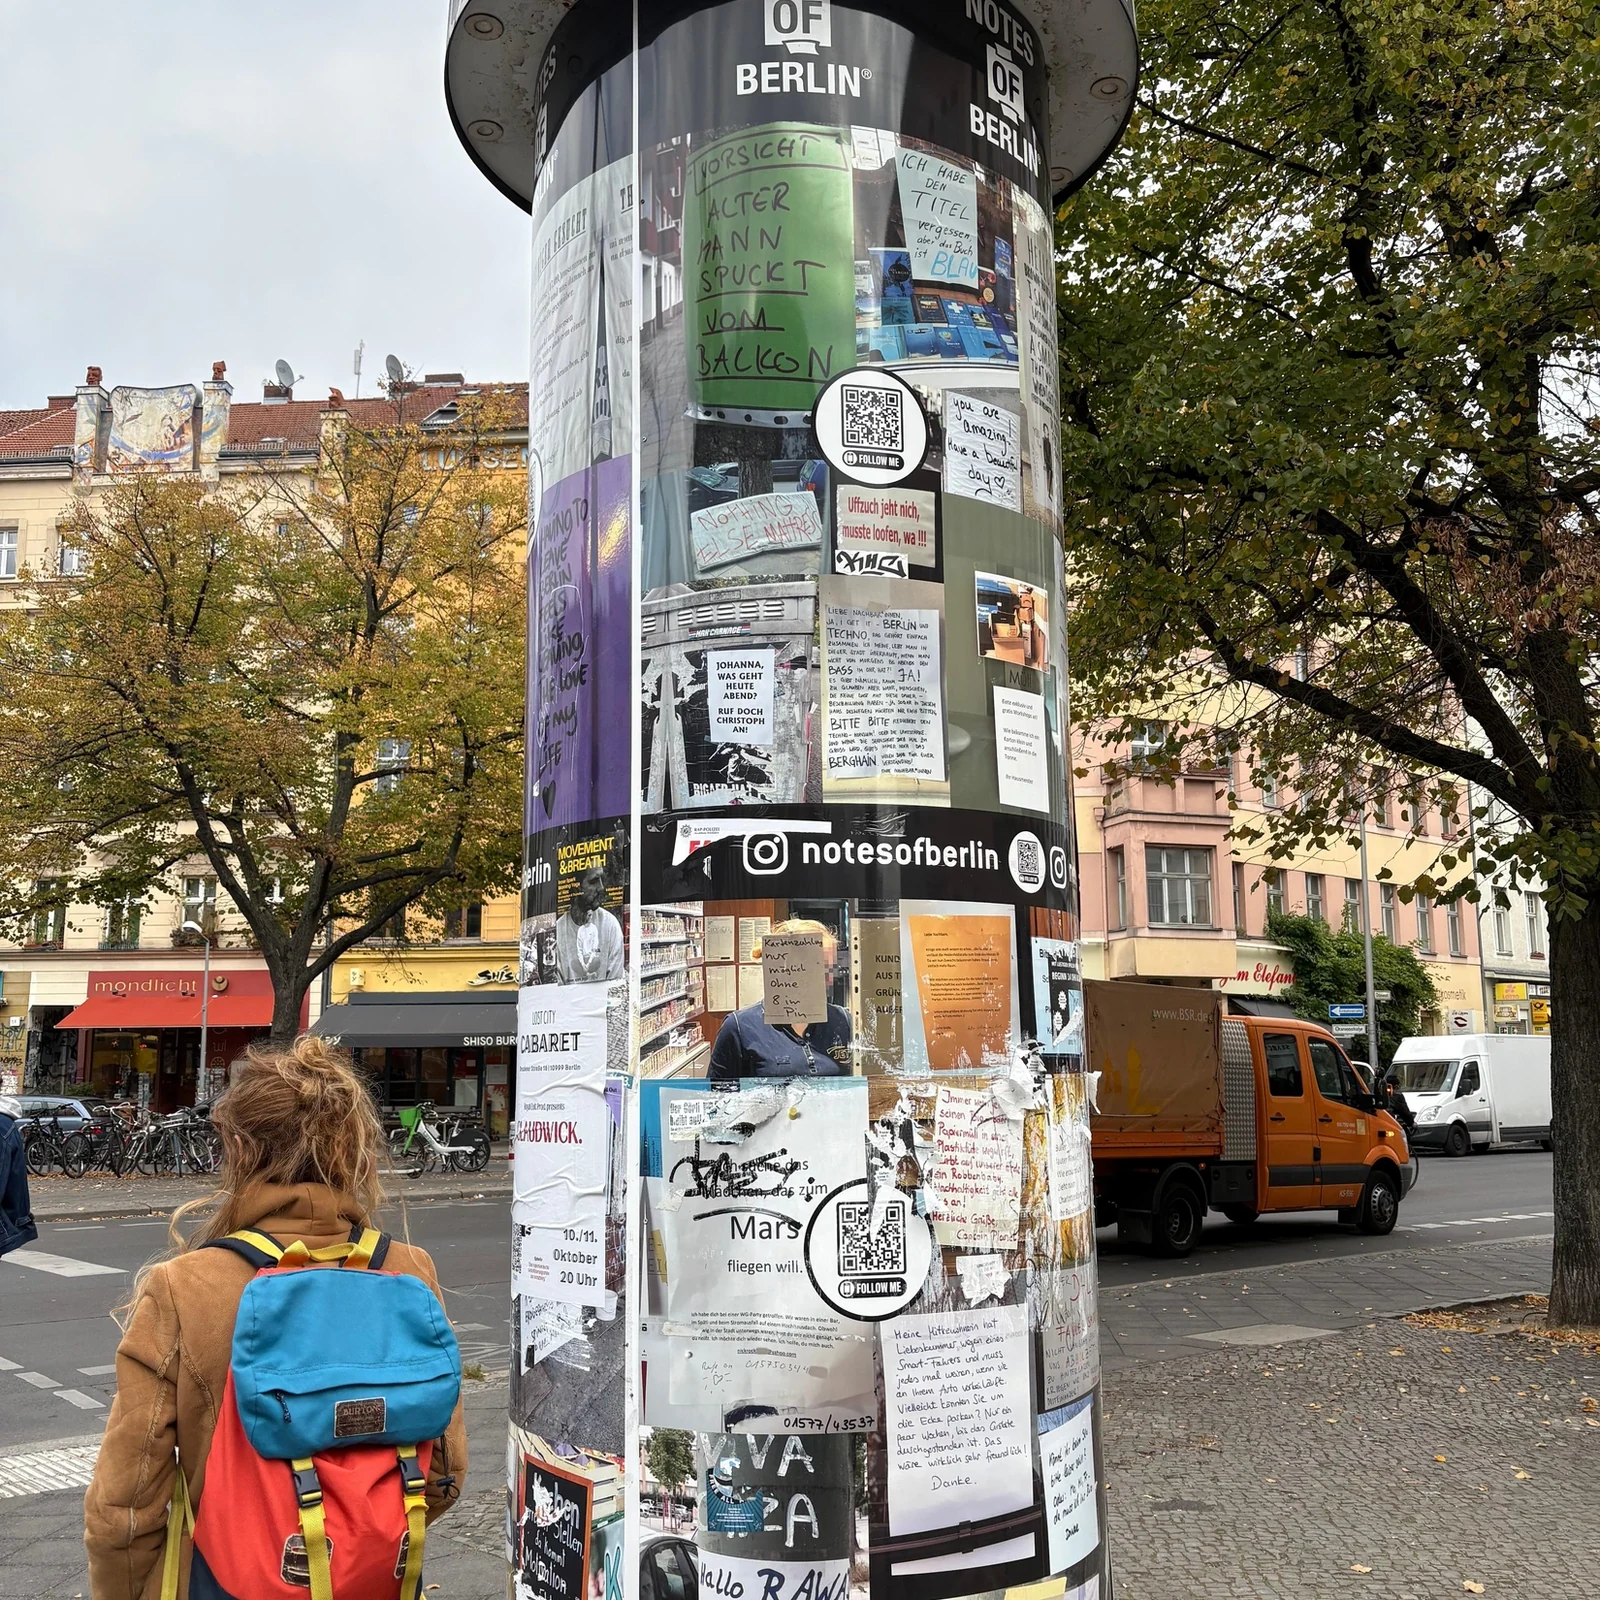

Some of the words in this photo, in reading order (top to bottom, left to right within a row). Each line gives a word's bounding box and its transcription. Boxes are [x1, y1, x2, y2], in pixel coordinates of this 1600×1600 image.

[773, 0, 822, 34] OF
[965, 0, 1034, 66] NOTES
[992, 61, 1020, 103] OF
[701, 135, 820, 178] VORSICHT
[901, 153, 928, 172] ICH
[937, 165, 968, 185] HABE
[925, 178, 947, 191] DEN
[911, 190, 970, 221] TITEL
[697, 225, 783, 265] MANN
[917, 235, 935, 245] aber
[953, 240, 973, 257] Buch
[914, 248, 929, 258] ist
[930, 250, 978, 279] BLAU
[701, 260, 826, 292] SPUCKT
[706, 307, 767, 333] VOM
[952, 397, 974, 420] you
[983, 405, 1000, 420] are
[948, 437, 967, 456] Have
[972, 451, 979, 459] a
[859, 454, 887, 466] FOLLOW
[889, 456, 900, 467] ME
[968, 465, 992, 497] day
[573, 498, 588, 527] TO
[697, 495, 793, 531] NOTHING
[848, 497, 879, 515] Uffzuch
[880, 499, 898, 519] jeht
[900, 501, 920, 522] nich,
[842, 524, 871, 540] musste
[873, 524, 902, 546] loofen,
[903, 531, 916, 545] wa
[918, 530, 927, 547] !!!
[697, 525, 759, 564] ELSE
[828, 607, 848, 615] LIEBE
[883, 619, 917, 631] BERLIN
[716, 661, 764, 671] JOHANNA,
[828, 665, 853, 676] BASS
[560, 664, 588, 692] LOVE
[717, 672, 737, 680] WAS
[739, 672, 763, 680] GEHT
[1009, 669, 1032, 688] Müll
[726, 682, 754, 690] HEUTE
[723, 692, 758, 700] ABEND?
[718, 707, 735, 715] RUF
[738, 707, 763, 715] DOCH
[716, 717, 765, 725] CHRISTOPH
[830, 717, 860, 731] BITTE
[868, 716, 890, 727] BITTE
[732, 726, 748, 734] AN!
[558, 837, 615, 860] MOVEMENT
[803, 837, 999, 871] notesofberlin
[559, 854, 606, 875] &BREATH
[765, 952, 789, 961] nur
[769, 963, 807, 975] möglich
[875, 972, 893, 980] AUS
[95, 979, 197, 992] mondlicht
[772, 995, 780, 1005] 8
[783, 1007, 807, 1019] Pin
[1153, 1009, 1209, 1022] www.BSR.de
[463, 1036, 493, 1046] SHISO
[521, 1032, 581, 1053] CABARET
[799, 1185, 827, 1195] zum
[731, 1216, 799, 1239] Mars
[563, 1229, 598, 1243] 10./11.
[553, 1249, 598, 1265] Oktober
[728, 1259, 771, 1275] fliegen
[776, 1260, 803, 1273] will.
[560, 1271, 574, 1284] 20
[576, 1272, 598, 1287] Uhr
[855, 1281, 888, 1294] FOLLOW
[889, 1280, 902, 1293] ME
[894, 1329, 921, 1339] Meine
[982, 1318, 998, 1329] hat
[960, 1337, 982, 1352] wegen
[986, 1336, 1004, 1344] eines
[966, 1354, 979, 1363] und
[896, 1375, 919, 1389] jedes
[922, 1372, 941, 1382] mal
[896, 1390, 907, 1398] an
[912, 1387, 934, 1396] Ihrem
[897, 1401, 938, 1414] Vielleicht
[784, 1415, 875, 1434] 01577/43537
[898, 1419, 914, 1429] die
[985, 1408, 1000, 1419] Nur
[970, 1424, 985, 1433] das
[985, 1437, 1002, 1446] Das
[931, 1475, 977, 1491] Danke.
[701, 1562, 744, 1599] Hallo
